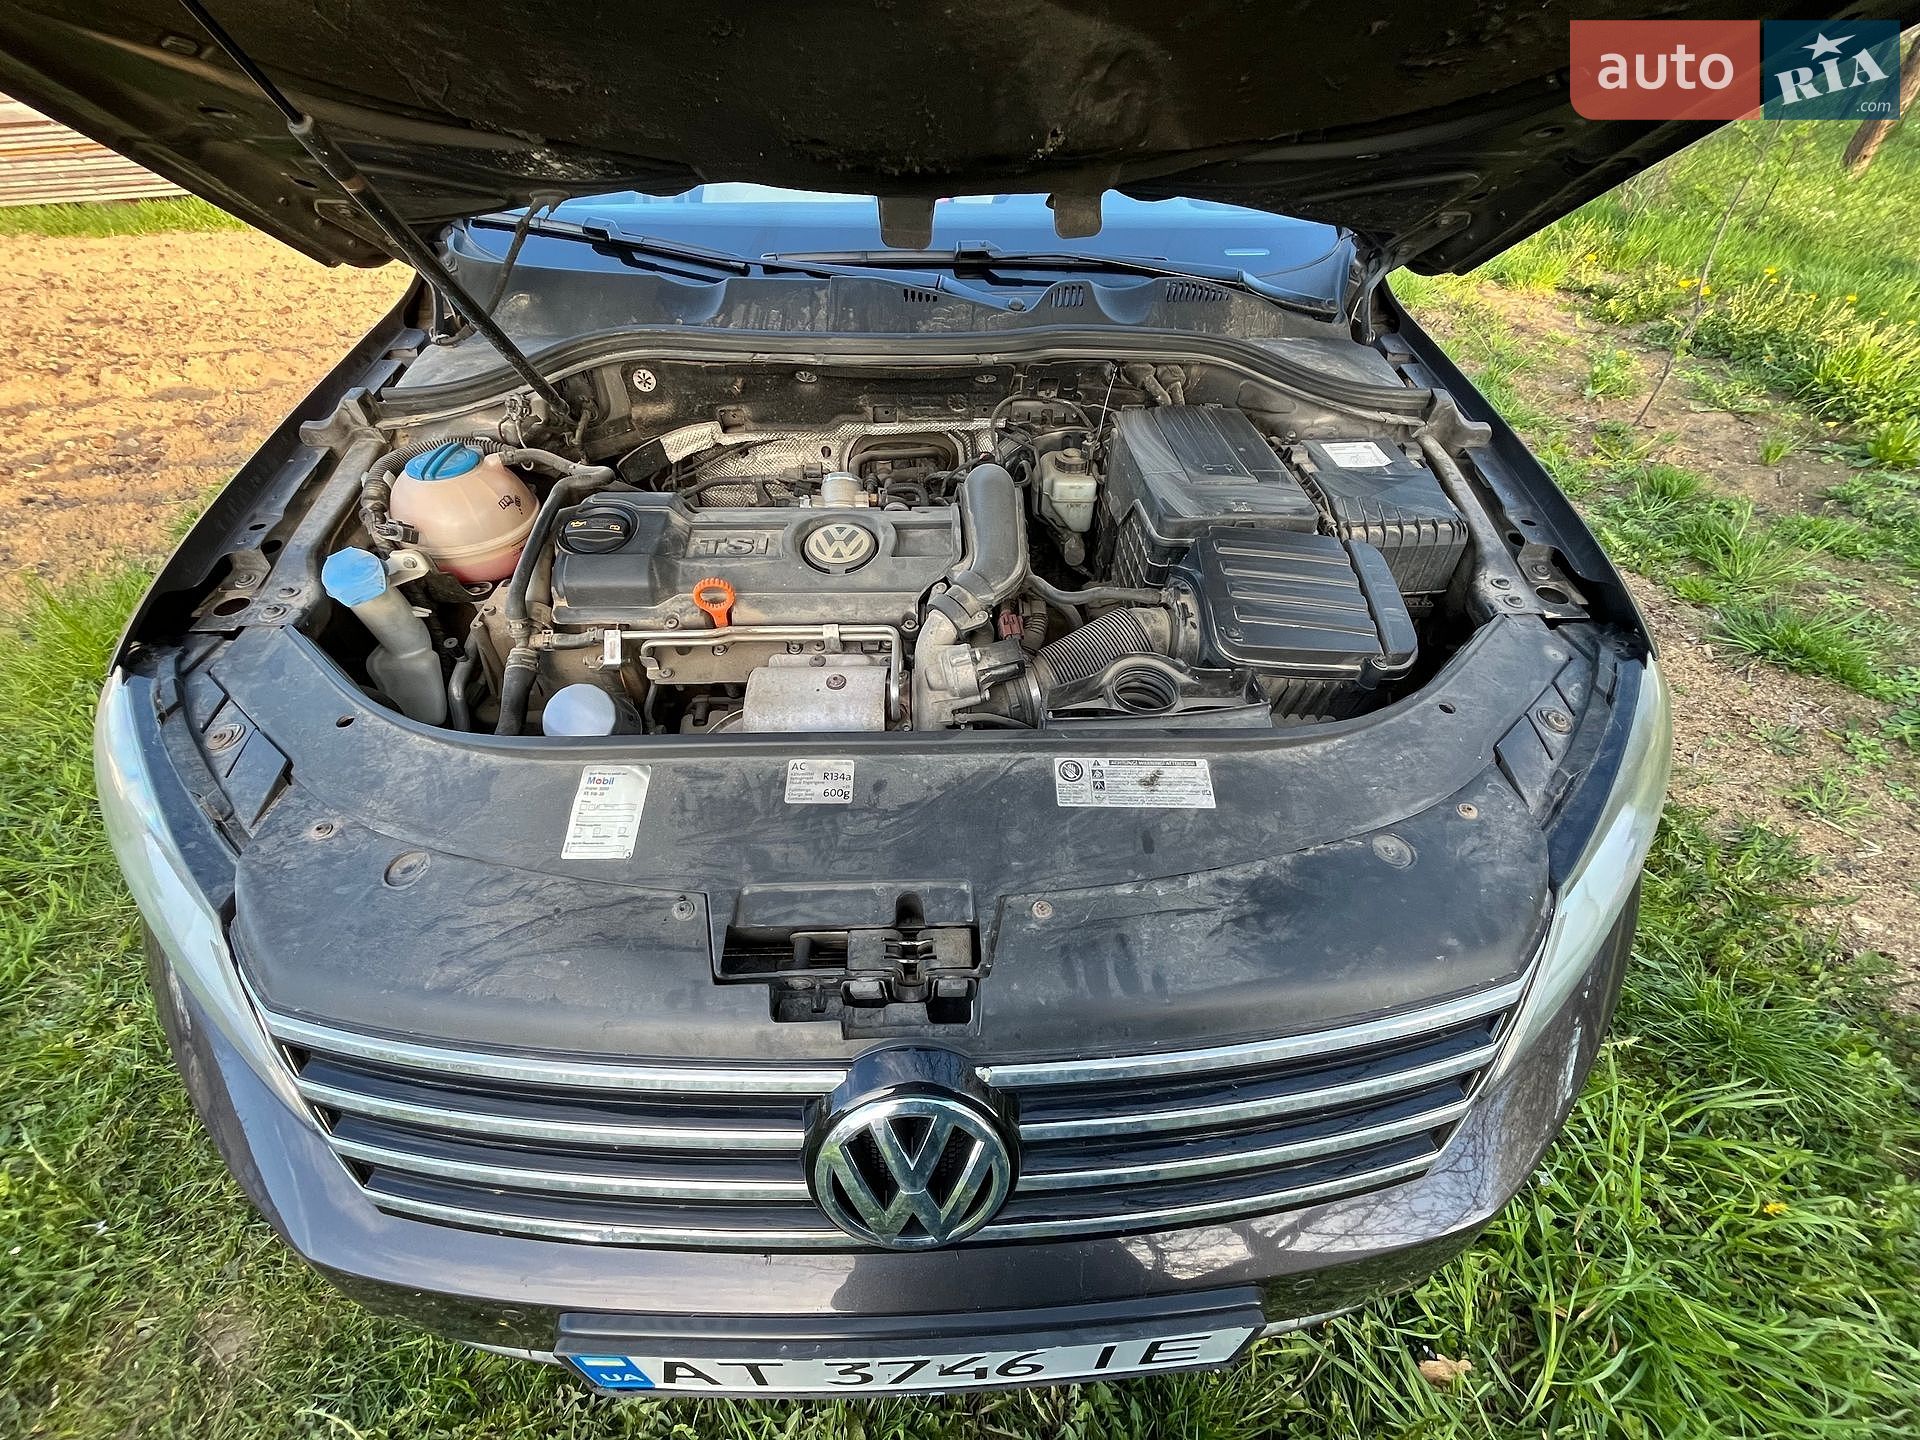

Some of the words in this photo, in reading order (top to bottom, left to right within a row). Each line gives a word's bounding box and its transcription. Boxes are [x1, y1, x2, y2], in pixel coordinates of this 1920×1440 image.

[700, 537, 769, 555] TSI
[791, 762, 806, 771] AC
[586, 776, 615, 785] Mobil
[823, 772, 852, 781] R134a
[823, 788, 851, 800] 600g
[663, 1360, 784, 1386] AT
[823, 1351, 1047, 1386] 3746
[1094, 1334, 1212, 1370] IE
[600, 1372, 645, 1382] UA
